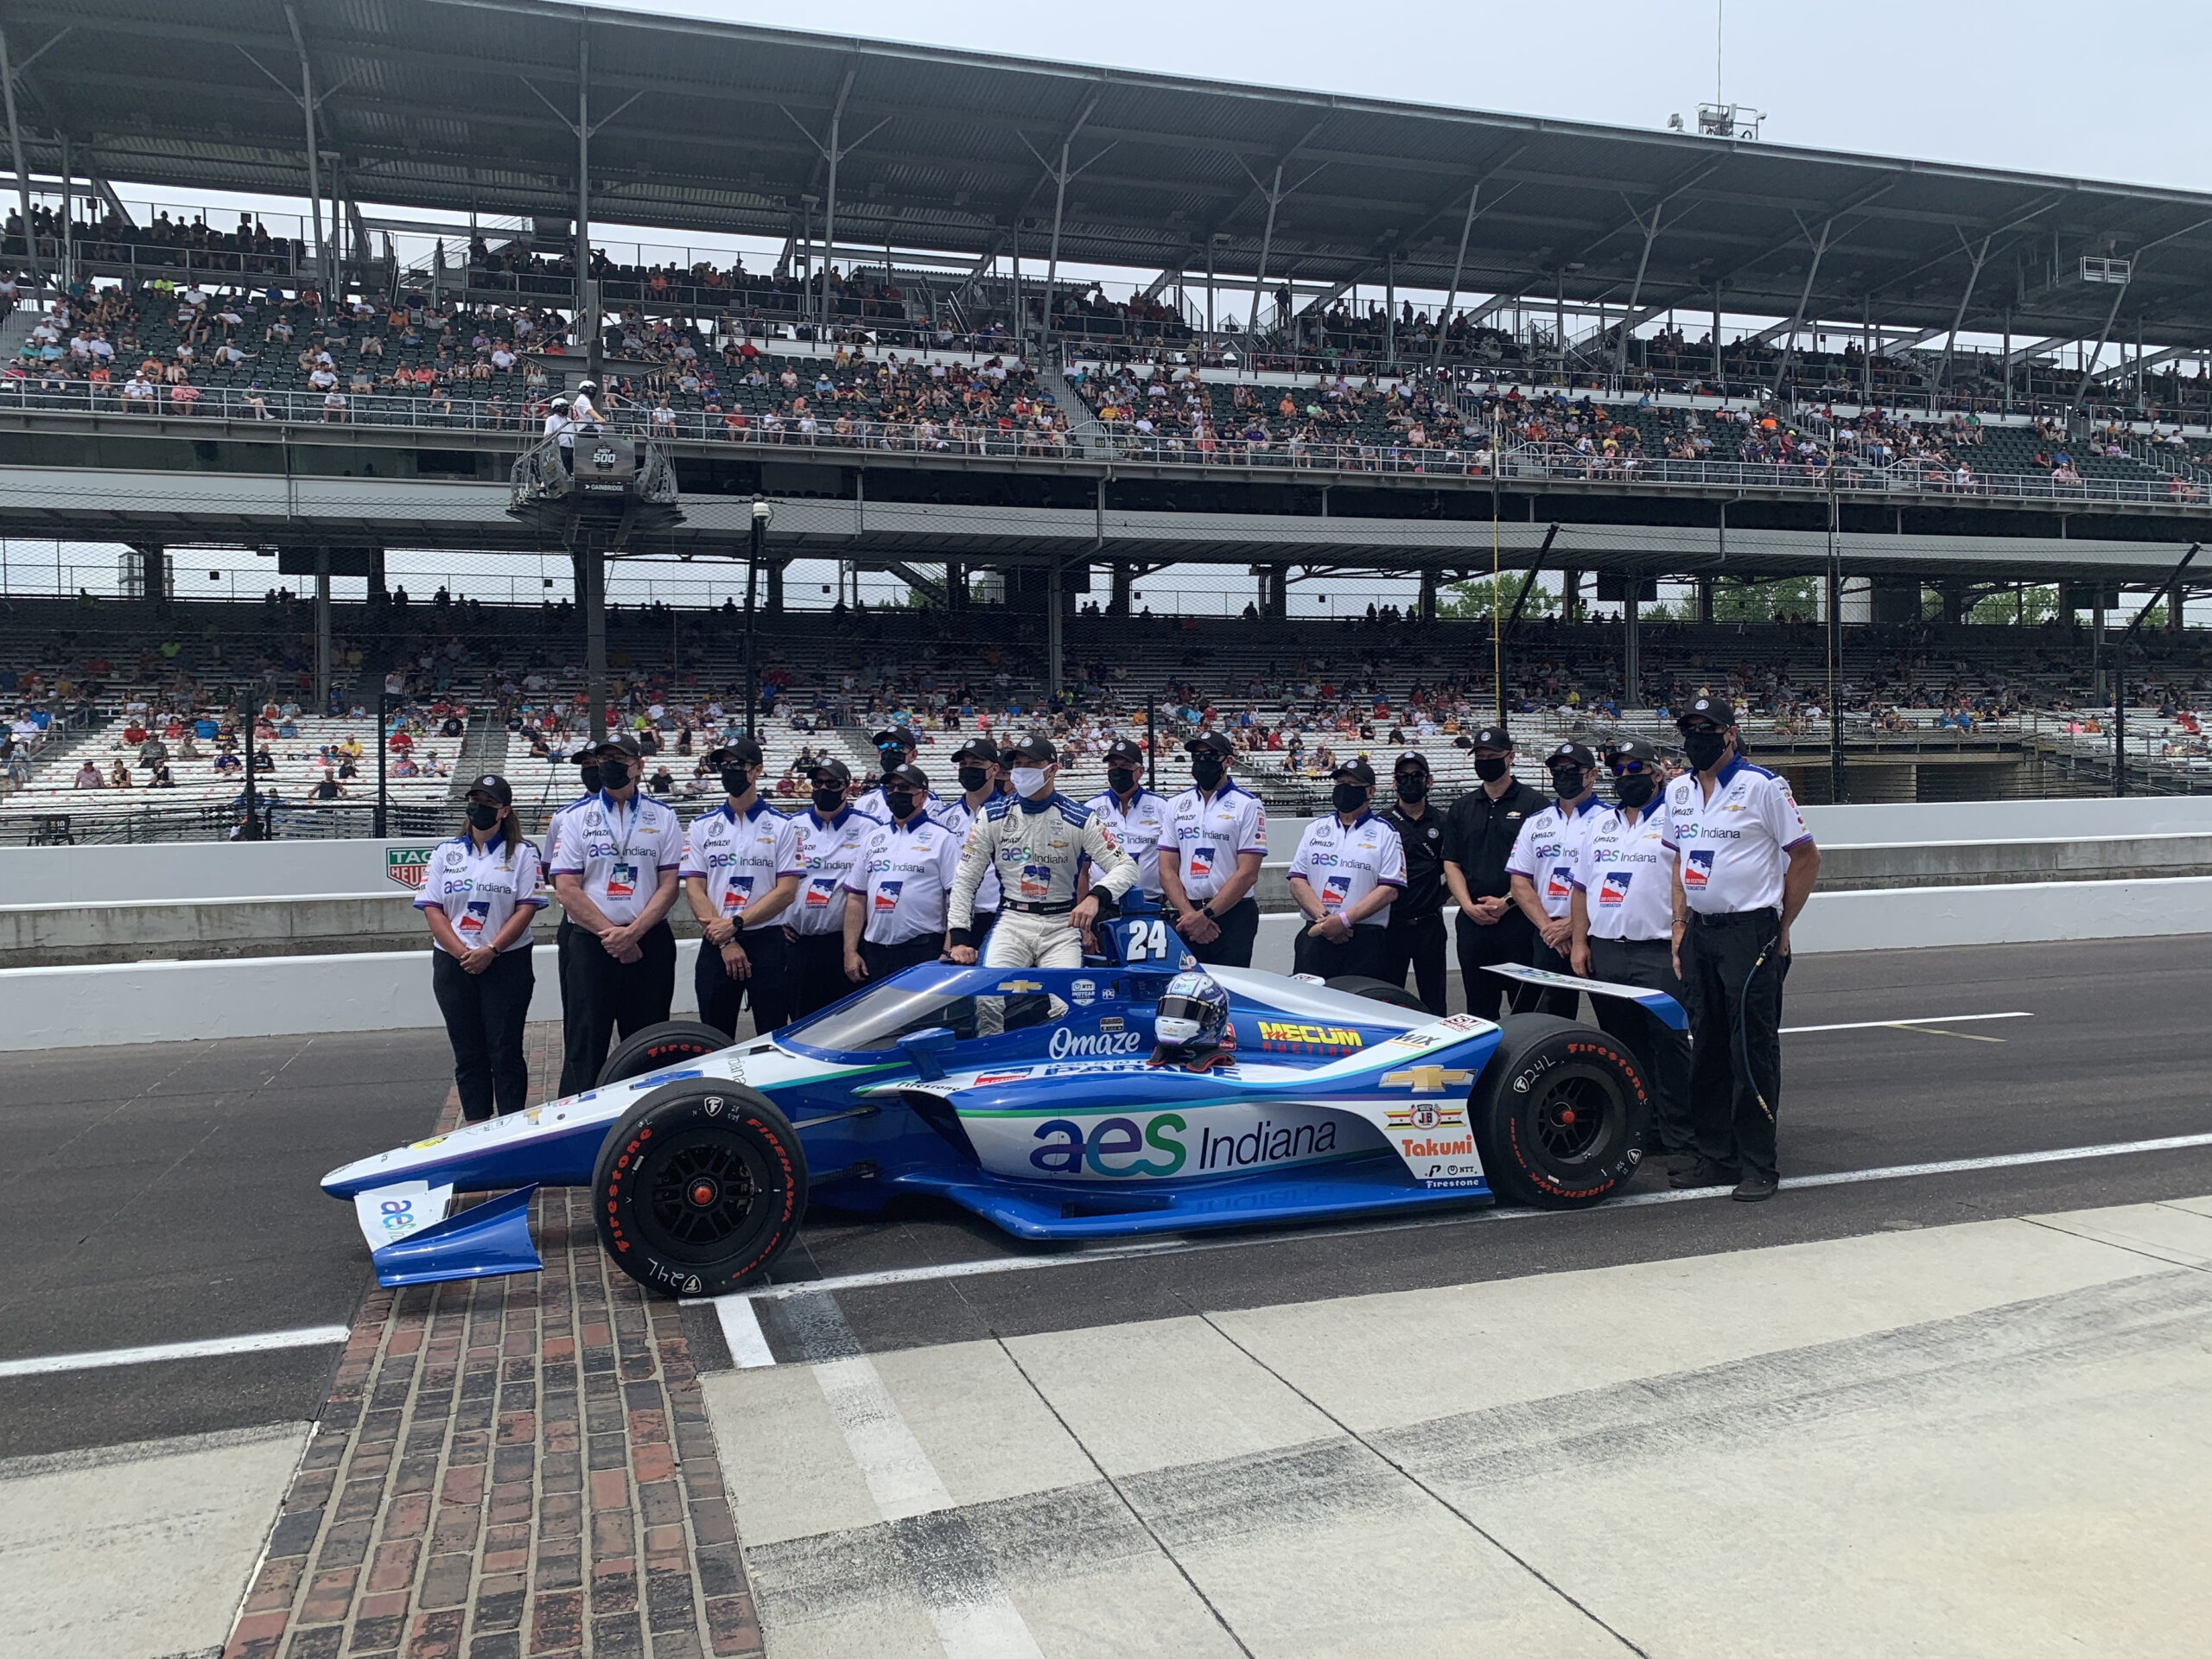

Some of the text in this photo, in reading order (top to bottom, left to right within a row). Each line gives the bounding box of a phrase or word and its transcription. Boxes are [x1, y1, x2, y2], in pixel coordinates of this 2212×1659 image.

[593, 453, 616, 463] 500
[1671, 806, 1694, 817] Omaze
[1177, 826, 1230, 842] aes Indiana
[1531, 831, 1555, 842] Omaze
[1674, 823, 1741, 840] aes Indiana
[703, 838, 731, 849] Omaze
[1127, 836, 1156, 844] Indiana
[1309, 837, 1335, 848] Omaze
[1593, 835, 1619, 845] Omaze
[391, 851, 433, 863] TAG
[588, 842, 620, 857] aes
[1001, 845, 1069, 864] aes Indiana
[1535, 844, 1580, 859] aes Indi
[1593, 849, 1656, 863] aes Indiana
[709, 853, 773, 868] aes Indiana
[804, 856, 852, 870] es Indian
[1311, 852, 1371, 871] aes Indiana
[391, 867, 427, 885] HEU
[893, 863, 925, 874] Indiana
[443, 878, 474, 894] aes
[476, 881, 512, 894] Indiana
[1126, 919, 1167, 962] 24
[1173, 982, 1192, 991] aes
[1257, 1020, 1363, 1047] MECUM
[1393, 1033, 1441, 1046] WIX
[1048, 1027, 1141, 1061] Omaze
[1524, 1054, 1556, 1084] 24L
[1567, 1042, 1645, 1101] Firestone
[896, 1081, 961, 1091] Firestone
[1029, 1112, 1337, 1178] aes Indiana
[1402, 1134, 1473, 1158] Takumi
[747, 1117, 794, 1224] FIREHAWK
[607, 1128, 652, 1253] Firestone
[1425, 1179, 1479, 1189] Firestone
[1528, 1171, 1616, 1198] FIREHAWK
[380, 1199, 417, 1230] aes
[647, 1257, 685, 1287] 24L
